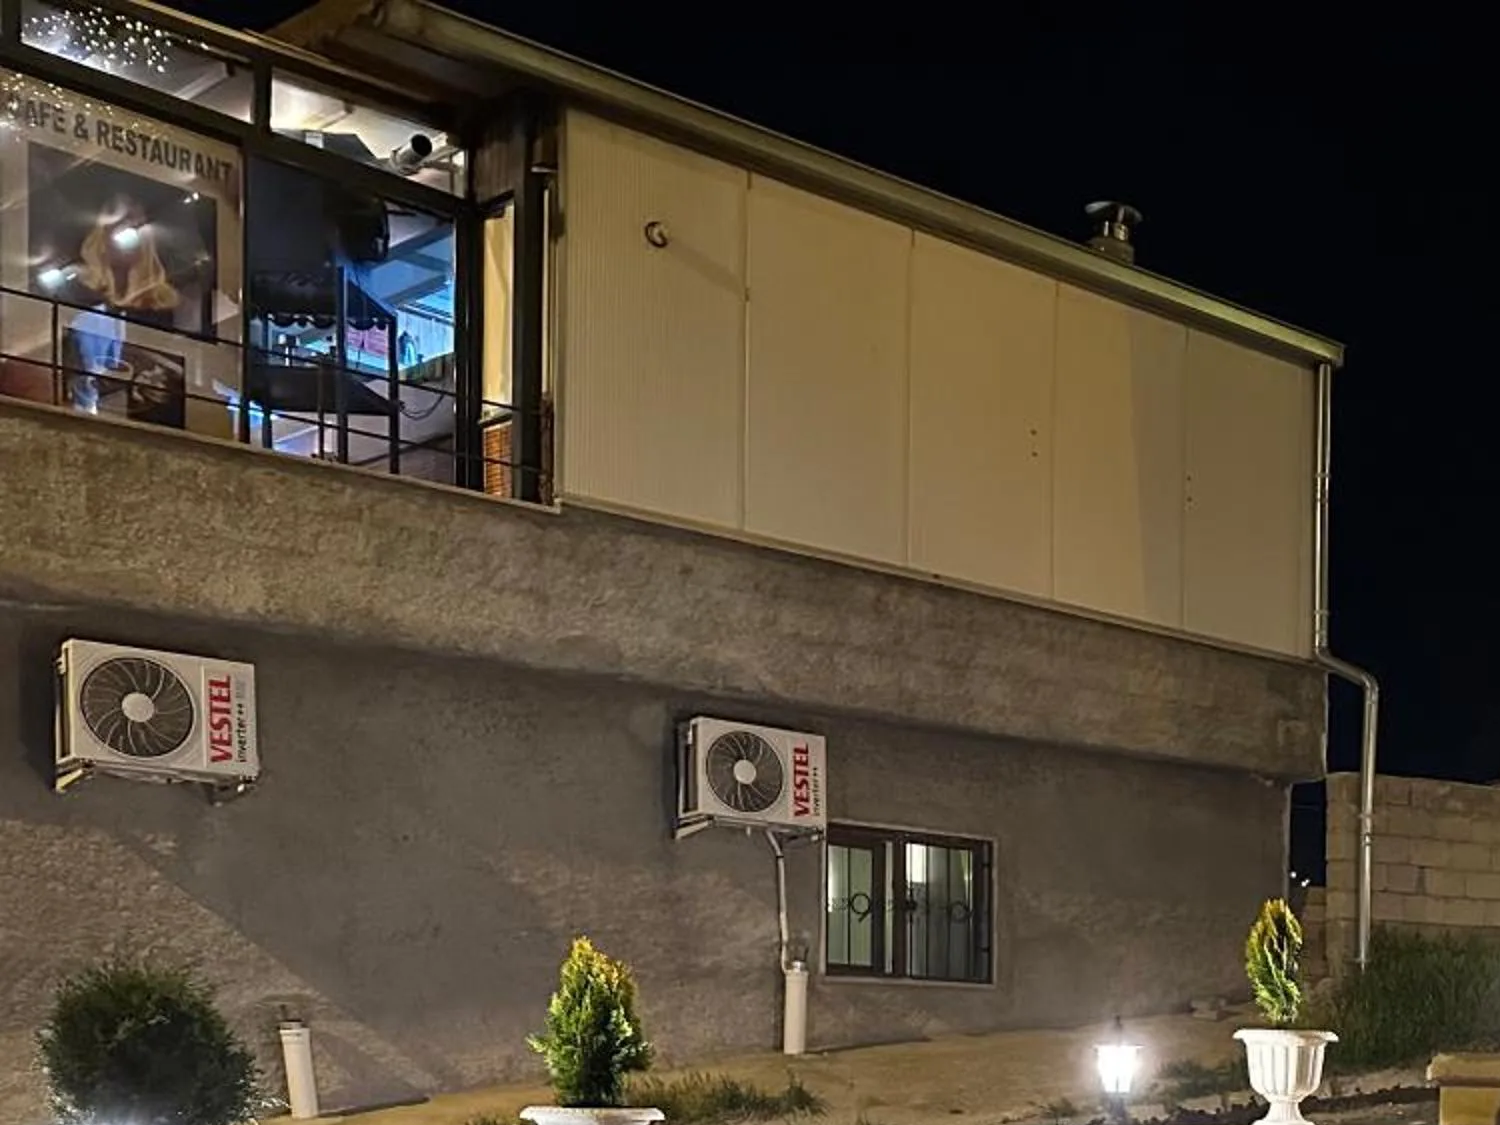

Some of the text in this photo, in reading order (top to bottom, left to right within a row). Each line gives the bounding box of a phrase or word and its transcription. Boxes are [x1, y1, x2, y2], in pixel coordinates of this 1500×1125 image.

[74, 113, 88, 140] &
[97, 120, 232, 182] RESTAURANT
[209, 674, 232, 762] VESTEL
[794, 743, 810, 816] VESTEL
